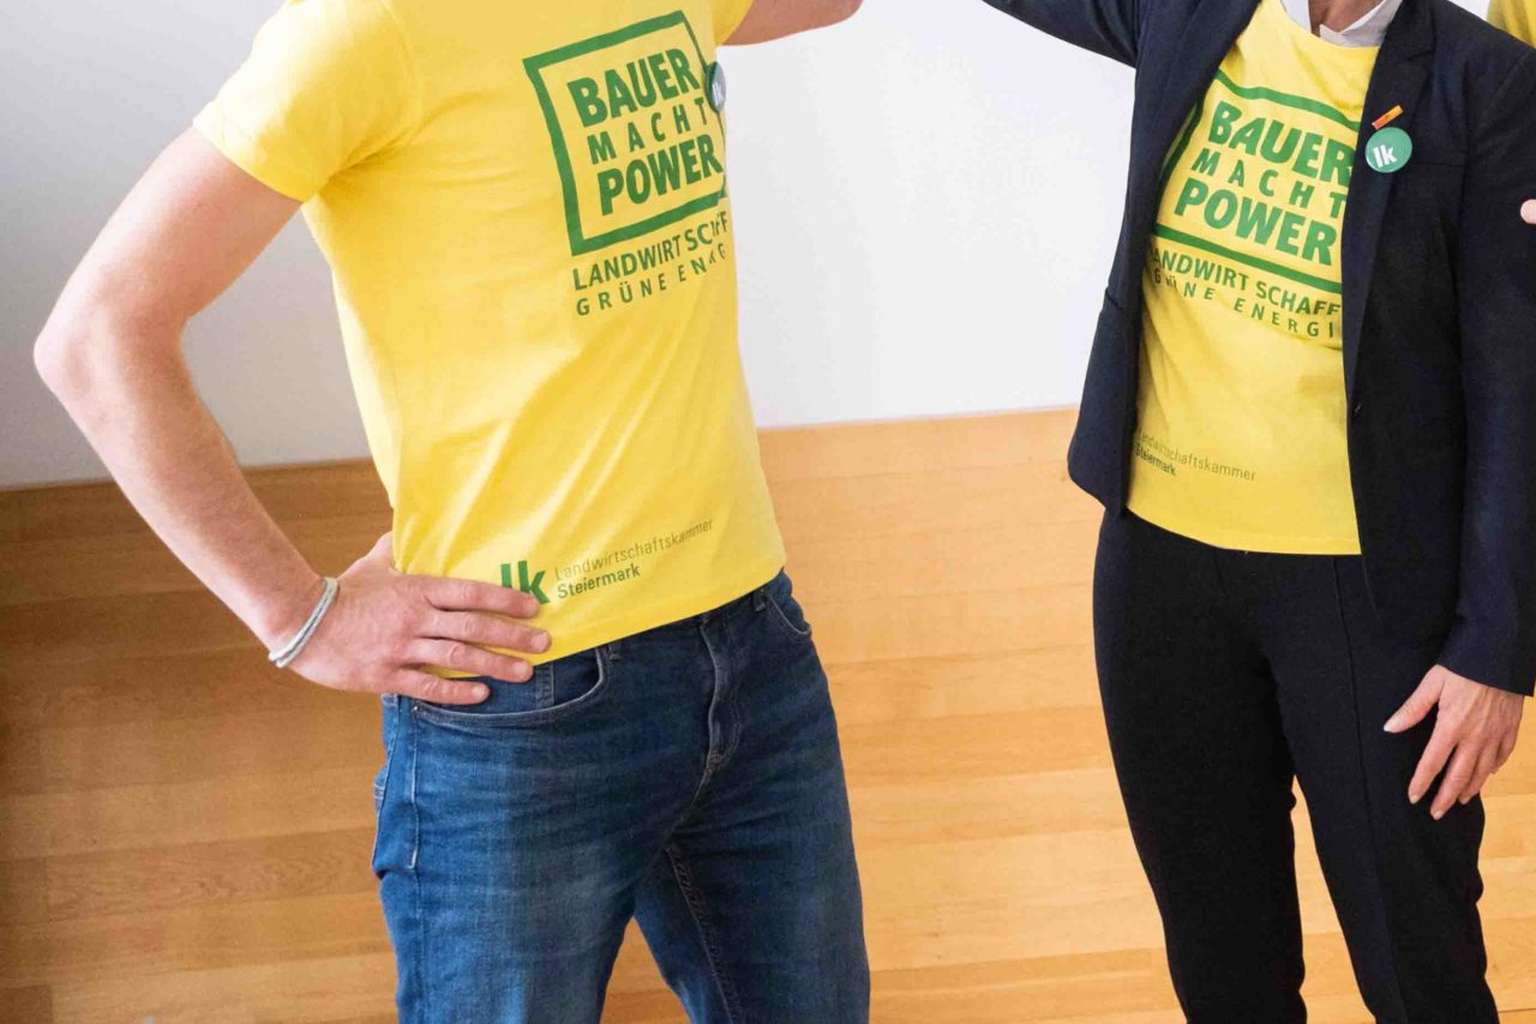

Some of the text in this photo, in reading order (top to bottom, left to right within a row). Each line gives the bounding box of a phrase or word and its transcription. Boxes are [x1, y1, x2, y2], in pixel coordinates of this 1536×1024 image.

[567, 48, 700, 128] BAUER
[587, 97, 708, 164] MACHT
[1208, 101, 1356, 188] BAUER
[1373, 144, 1398, 168] lk
[597, 133, 723, 216] POWER
[1191, 147, 1348, 219] MACHT
[1174, 177, 1336, 265] POWER
[577, 273, 666, 316] GRÜNE
[1233, 298, 1334, 338] ENERGI
[557, 563, 641, 599] Steiermark
